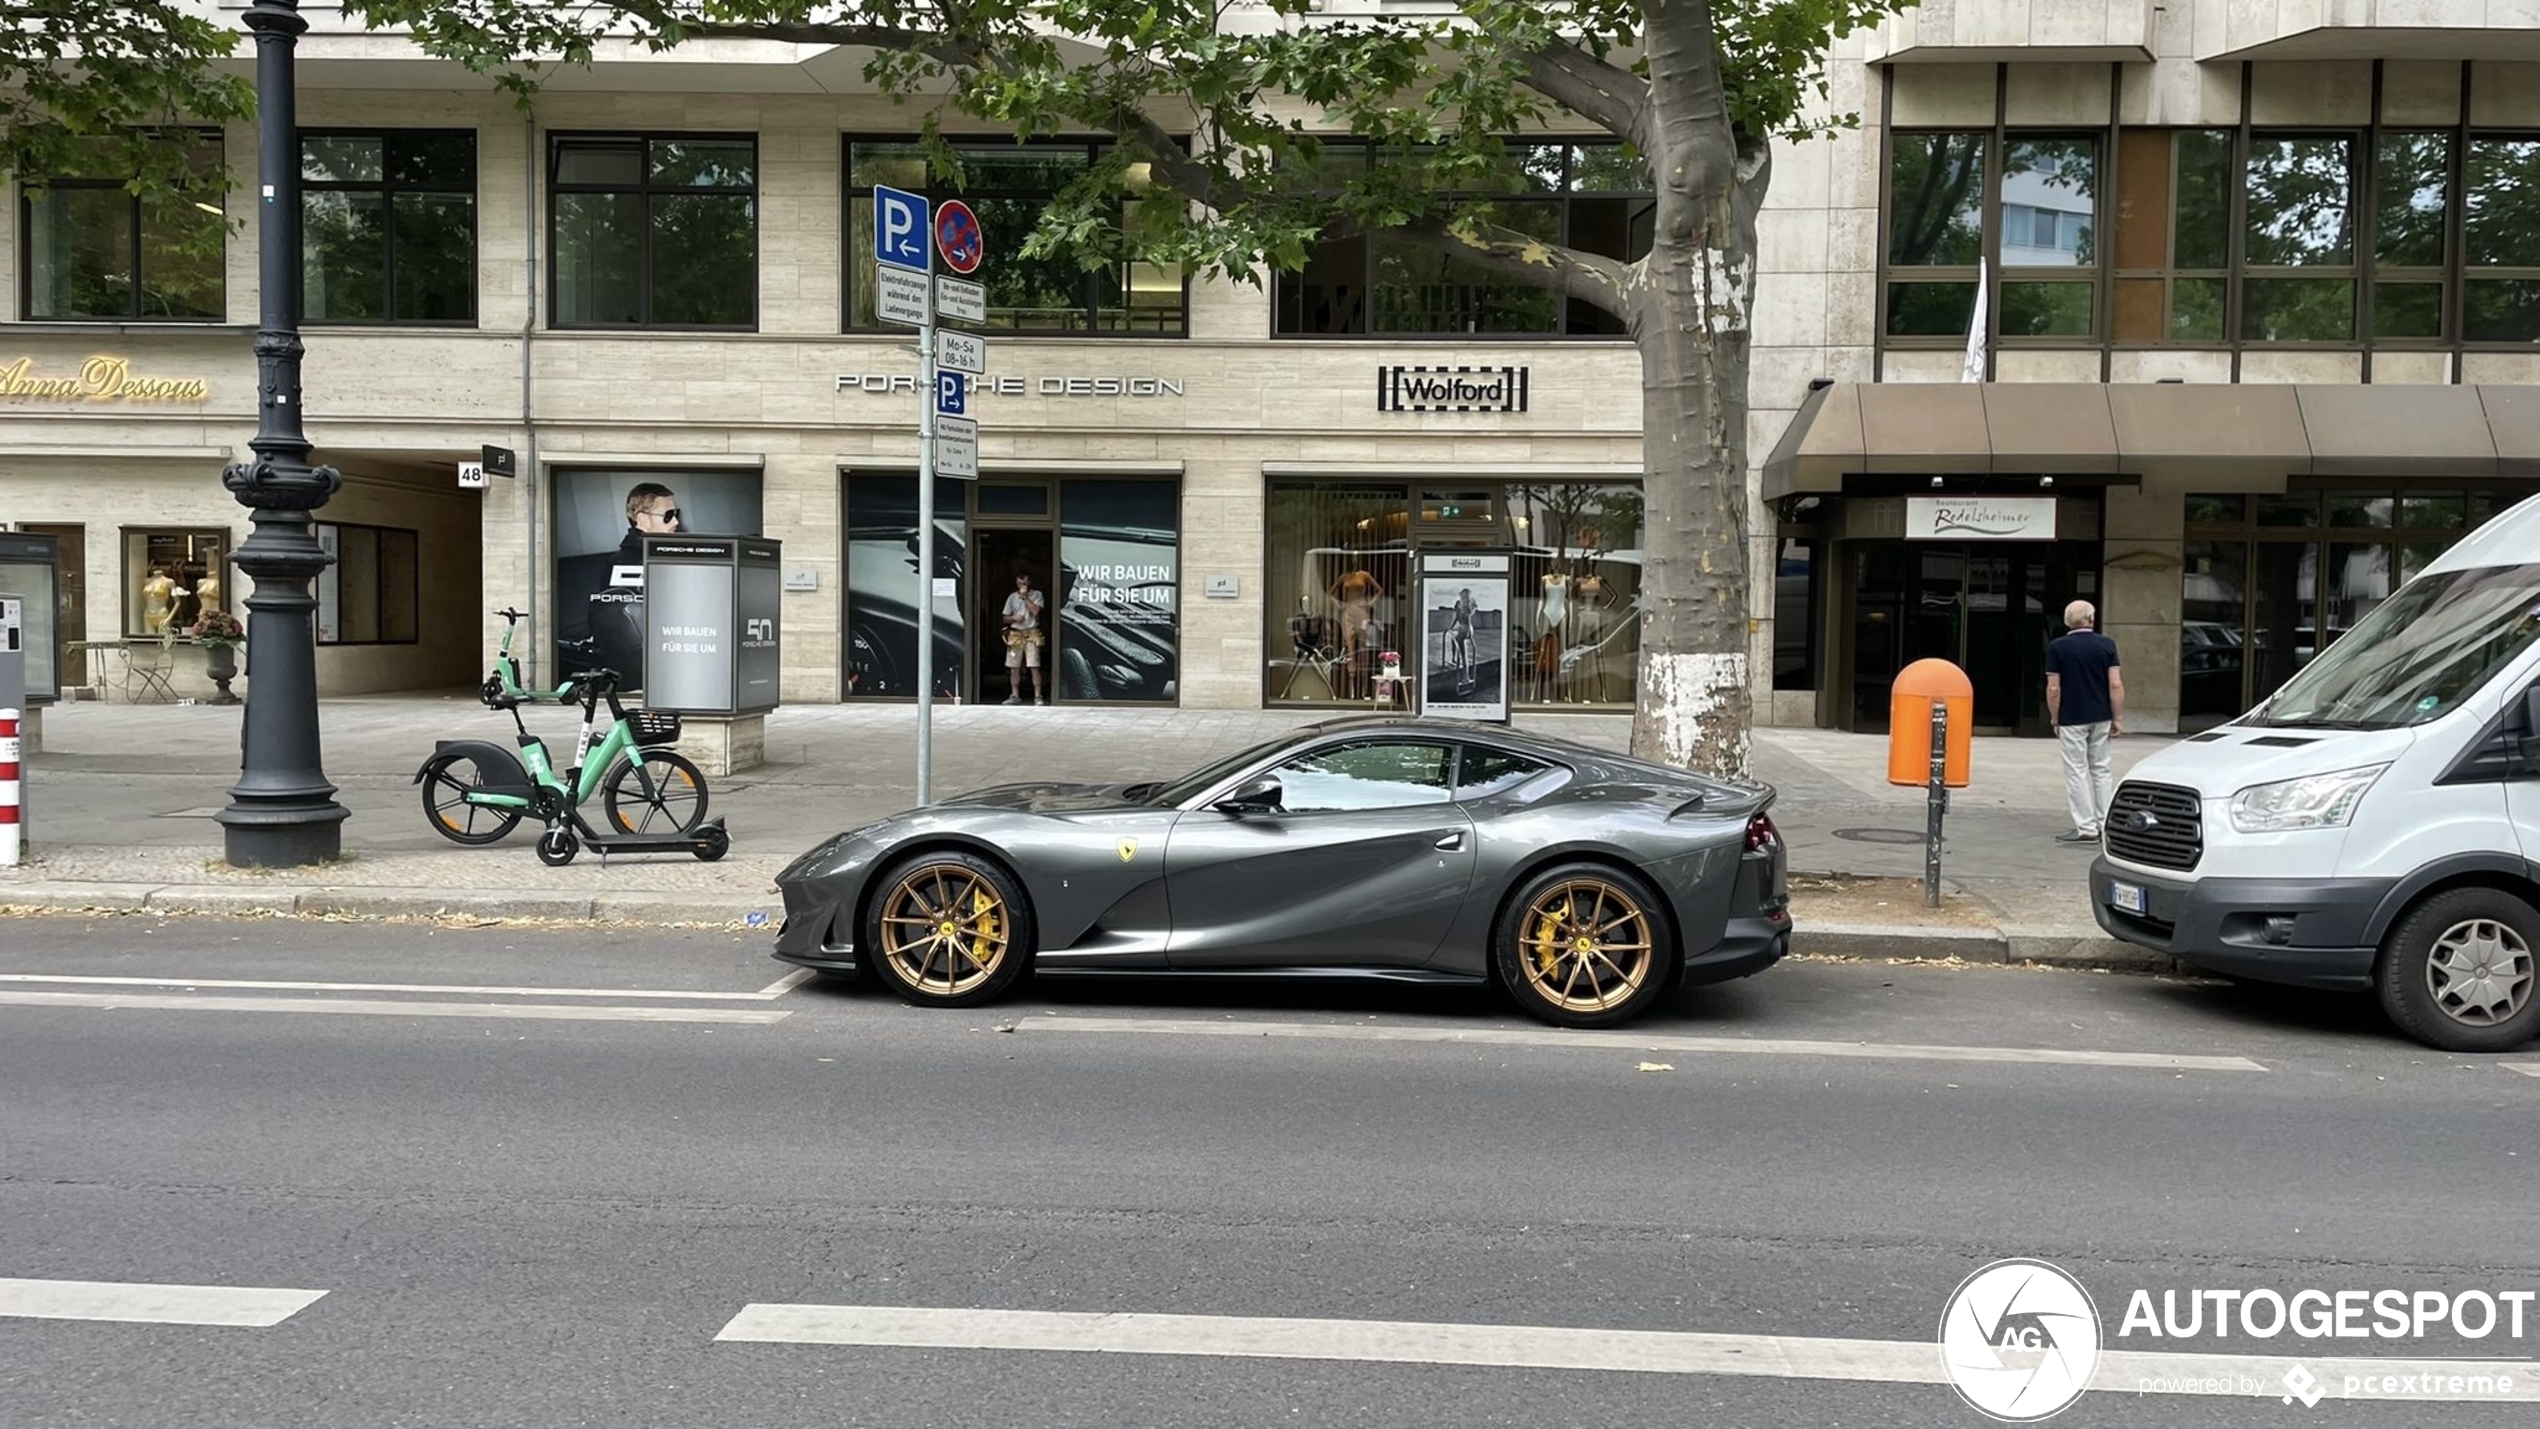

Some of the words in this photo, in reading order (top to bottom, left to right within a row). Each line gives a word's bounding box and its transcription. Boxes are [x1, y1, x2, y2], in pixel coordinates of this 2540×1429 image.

[885, 197, 912, 253] P
[881, 272, 927, 291] Elektrofahrzeuge
[887, 288, 910, 301] während
[885, 303, 923, 319] Ladevorgangs
[946, 338, 974, 354] Mo-Sa
[969, 356, 975, 367] h
[0, 357, 79, 397] Anna
[80, 357, 204, 397] Dessous
[835, 375, 1025, 393] PORHE
[1039, 377, 1184, 395] DESIGN
[941, 376, 957, 408] P
[1404, 378, 1502, 401] Wolford
[462, 467, 481, 481] 48
[1934, 506, 2031, 527] Redelsheimer
[1078, 564, 1111, 580] WIR
[1114, 565, 1170, 581] BAUEN
[1078, 584, 1112, 602] FÜR
[1114, 587, 1139, 603] SIE
[1144, 588, 1170, 603] UM
[662, 626, 683, 636] WIR
[683, 626, 717, 637] BAUEN
[662, 641, 683, 653] FÜR
[683, 643, 699, 654] SIE
[700, 644, 717, 654] UM
[879, 681, 886, 690] 2
